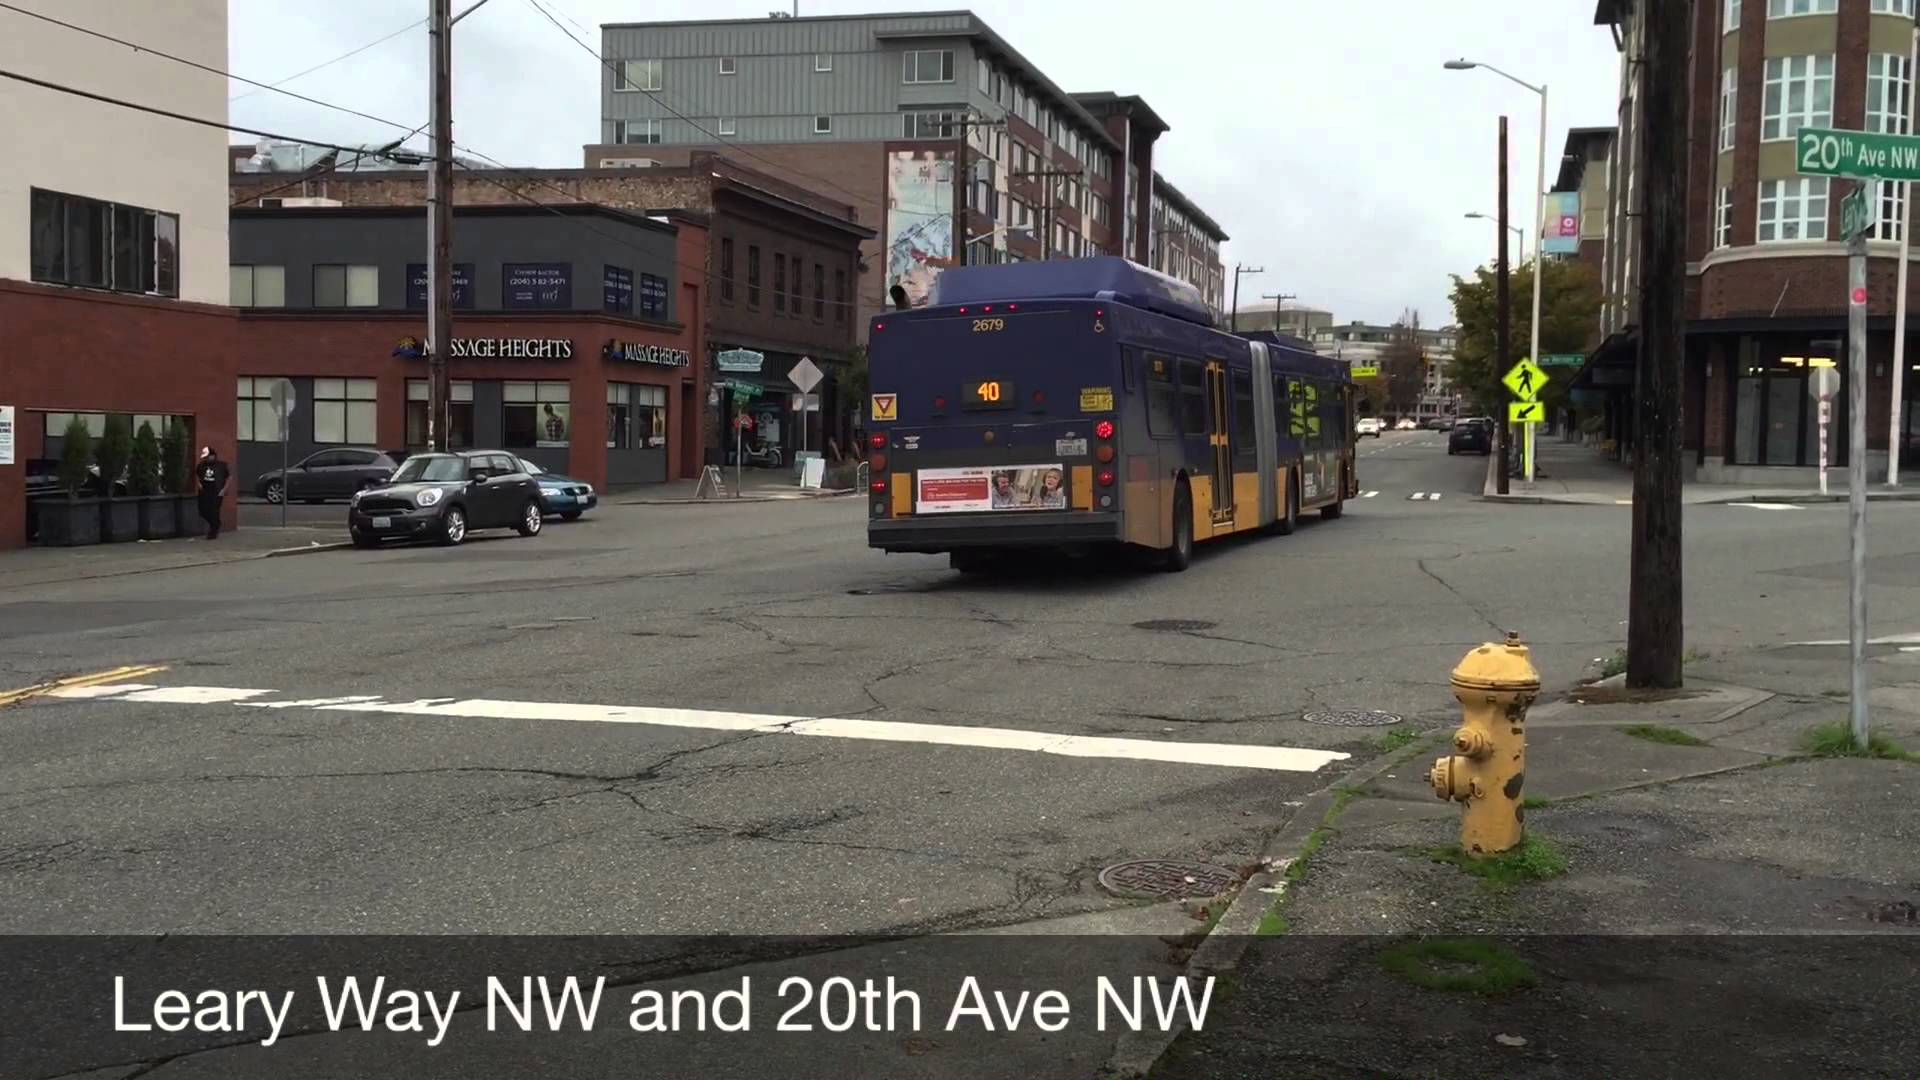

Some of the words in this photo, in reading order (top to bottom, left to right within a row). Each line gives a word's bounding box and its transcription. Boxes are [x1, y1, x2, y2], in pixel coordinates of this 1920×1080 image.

[1801, 133, 1853, 170] 20th
[1857, 143, 1886, 168] Ave
[1891, 146, 1918, 170] NW
[972, 318, 1004, 332] 2679
[422, 337, 495, 359] MSSAGE
[498, 338, 572, 359] HEIGHTS
[624, 343, 660, 363] MASSAGE
[659, 347, 691, 368] HEIGHTS
[977, 381, 1000, 402] 40
